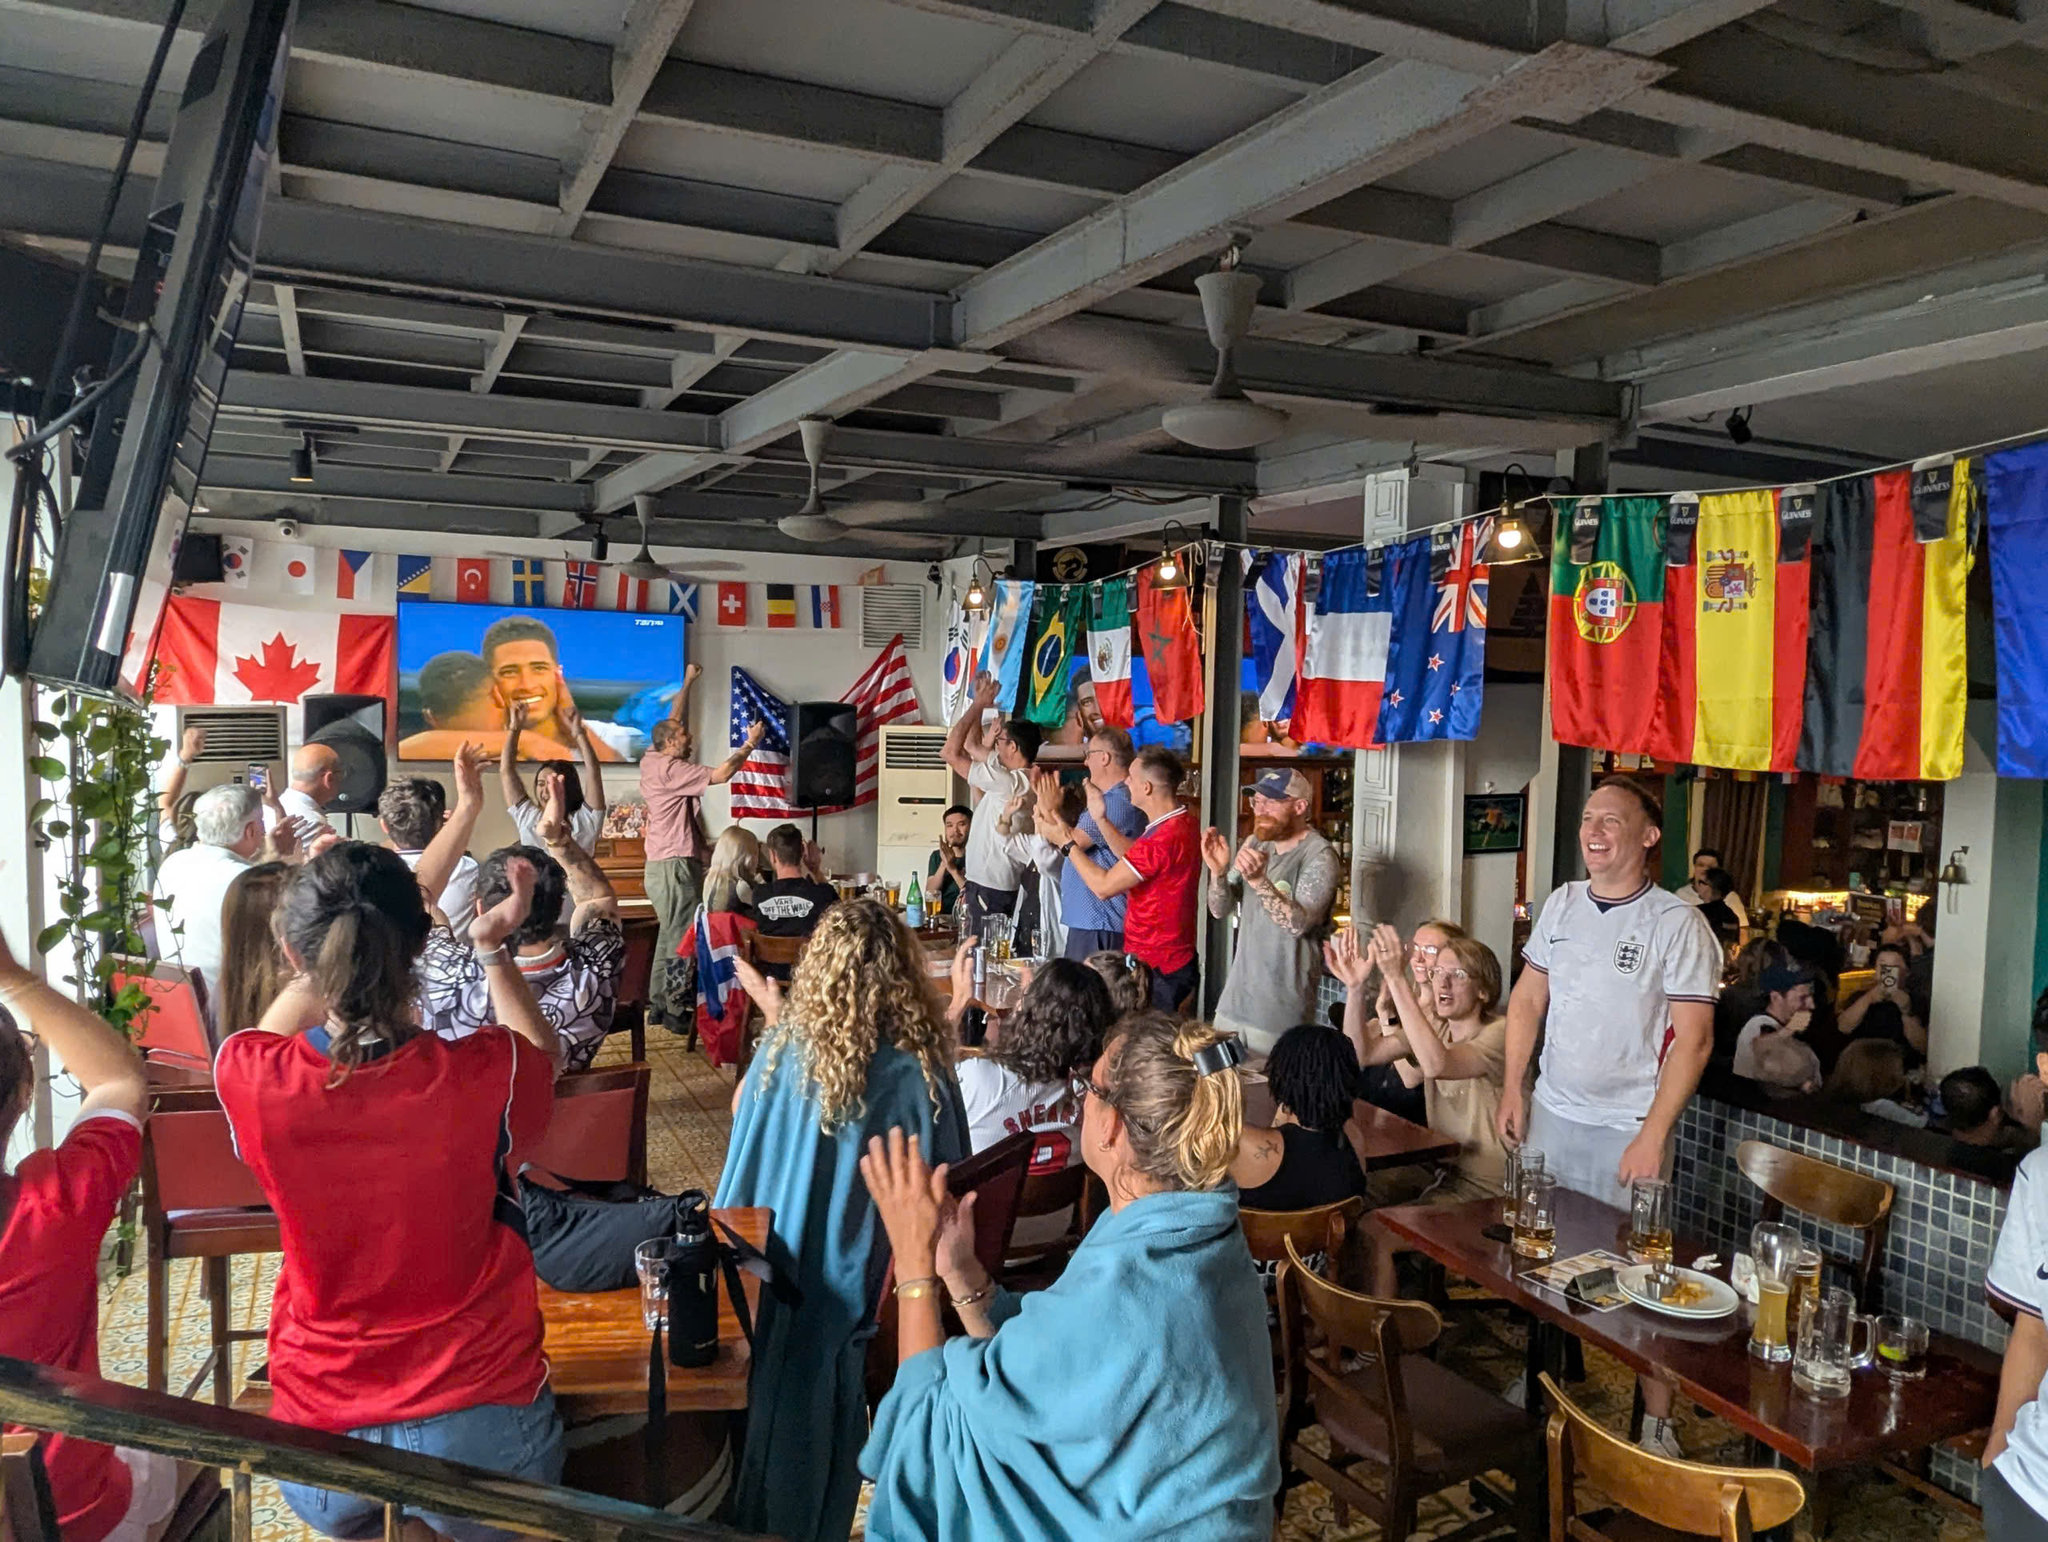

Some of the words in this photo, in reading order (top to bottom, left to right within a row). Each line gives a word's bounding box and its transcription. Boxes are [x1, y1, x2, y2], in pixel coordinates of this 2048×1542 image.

[1913, 482, 1950, 495] GUINNESS
[1781, 510, 1812, 520] GUINNESS
[774, 897, 793, 905] VANS
[777, 905, 791, 915] THE
